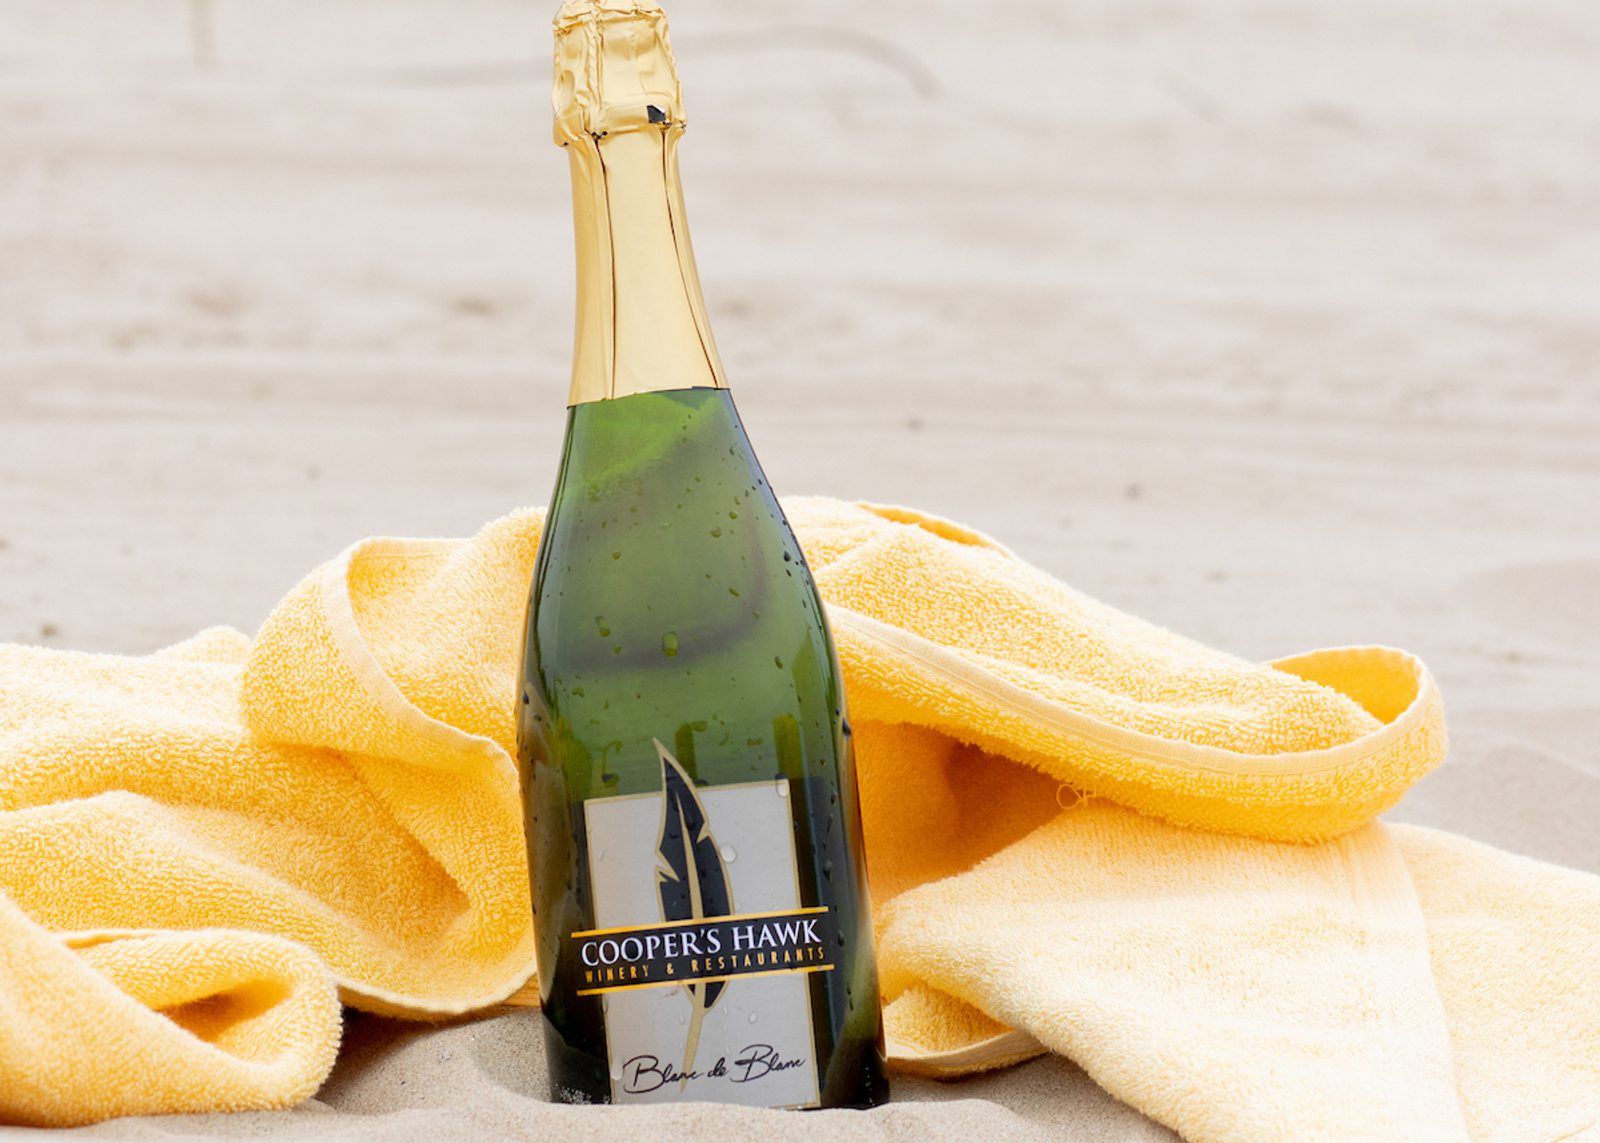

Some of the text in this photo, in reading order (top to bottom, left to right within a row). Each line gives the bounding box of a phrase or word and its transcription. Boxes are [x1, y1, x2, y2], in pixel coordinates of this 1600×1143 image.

[581, 919, 821, 967] COOPER'S HAWK
[585, 947, 824, 983] WINERY & RESTAURANTS
[623, 1044, 806, 1094] Blanc de Blanc
